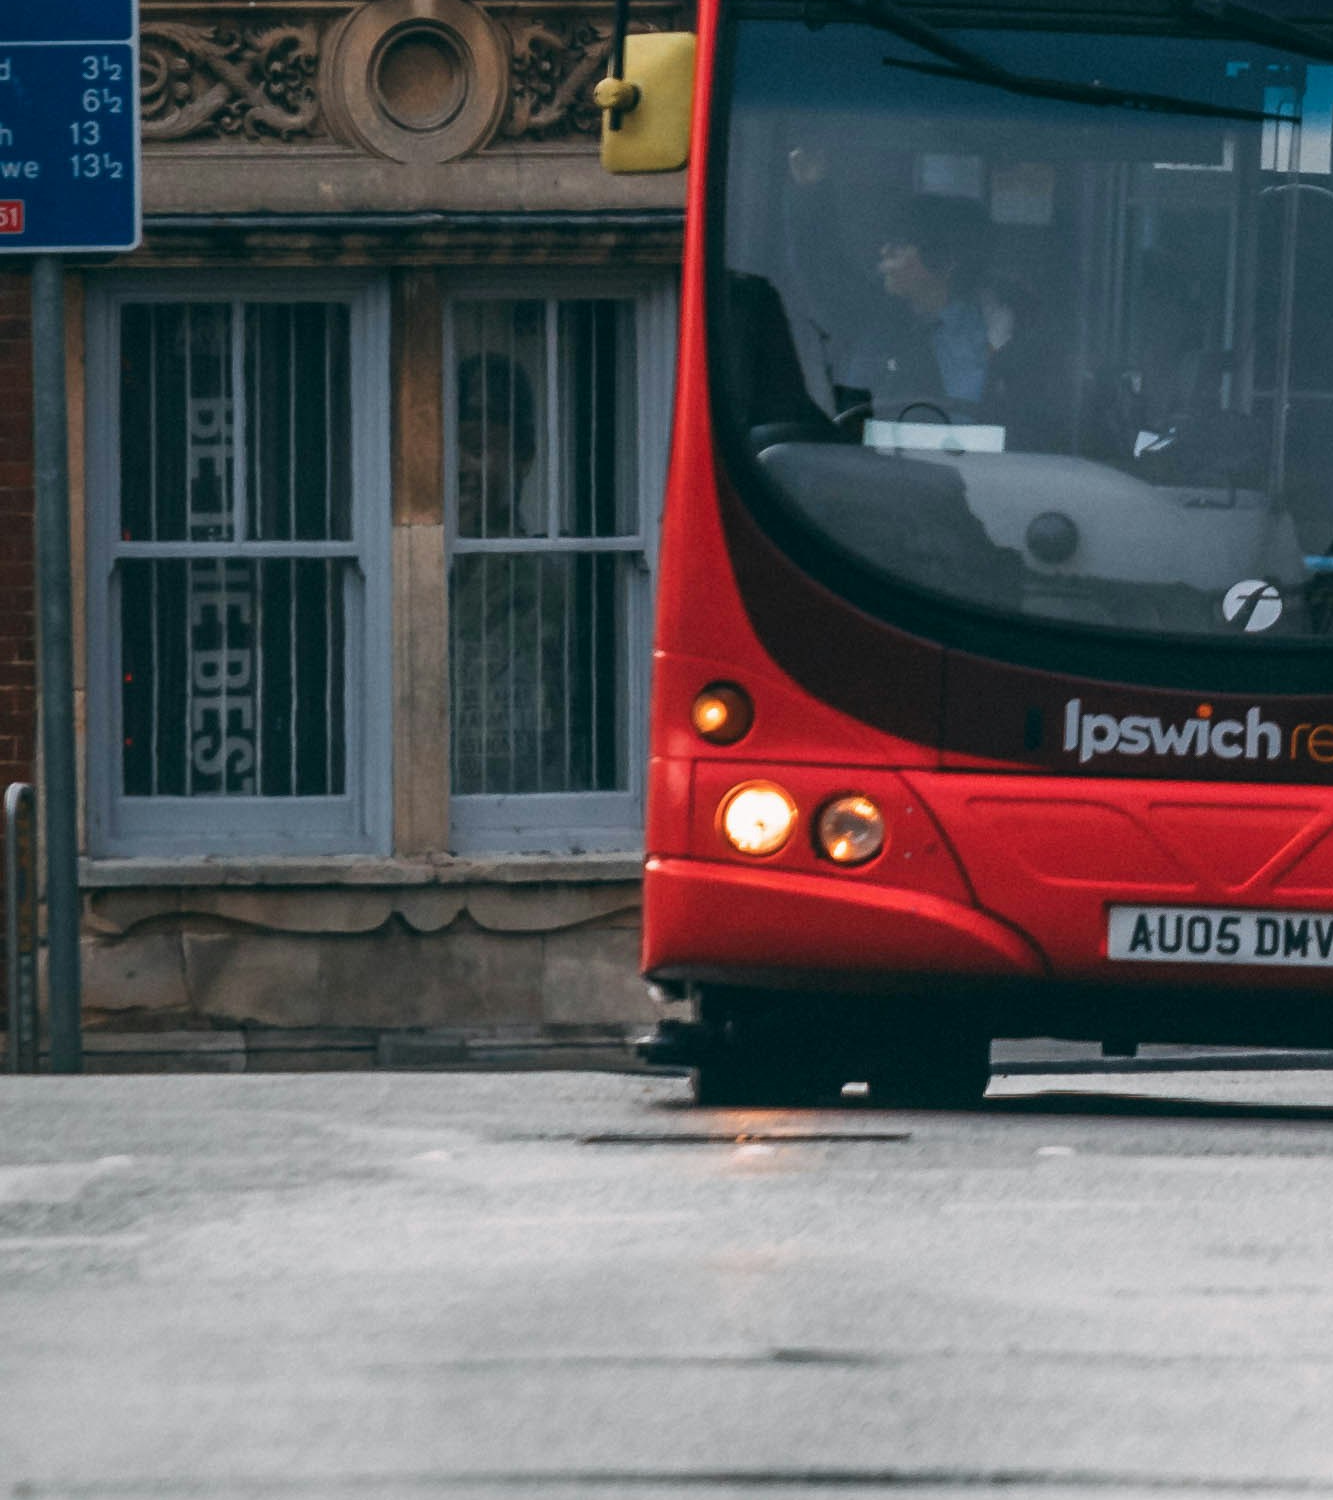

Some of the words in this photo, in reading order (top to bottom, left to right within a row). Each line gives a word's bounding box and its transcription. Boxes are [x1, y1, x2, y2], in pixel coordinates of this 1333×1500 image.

[70, 121, 100, 145] 13
[1063, 698, 1283, 764] Ipswich
[1129, 913, 1242, 956] AU05
